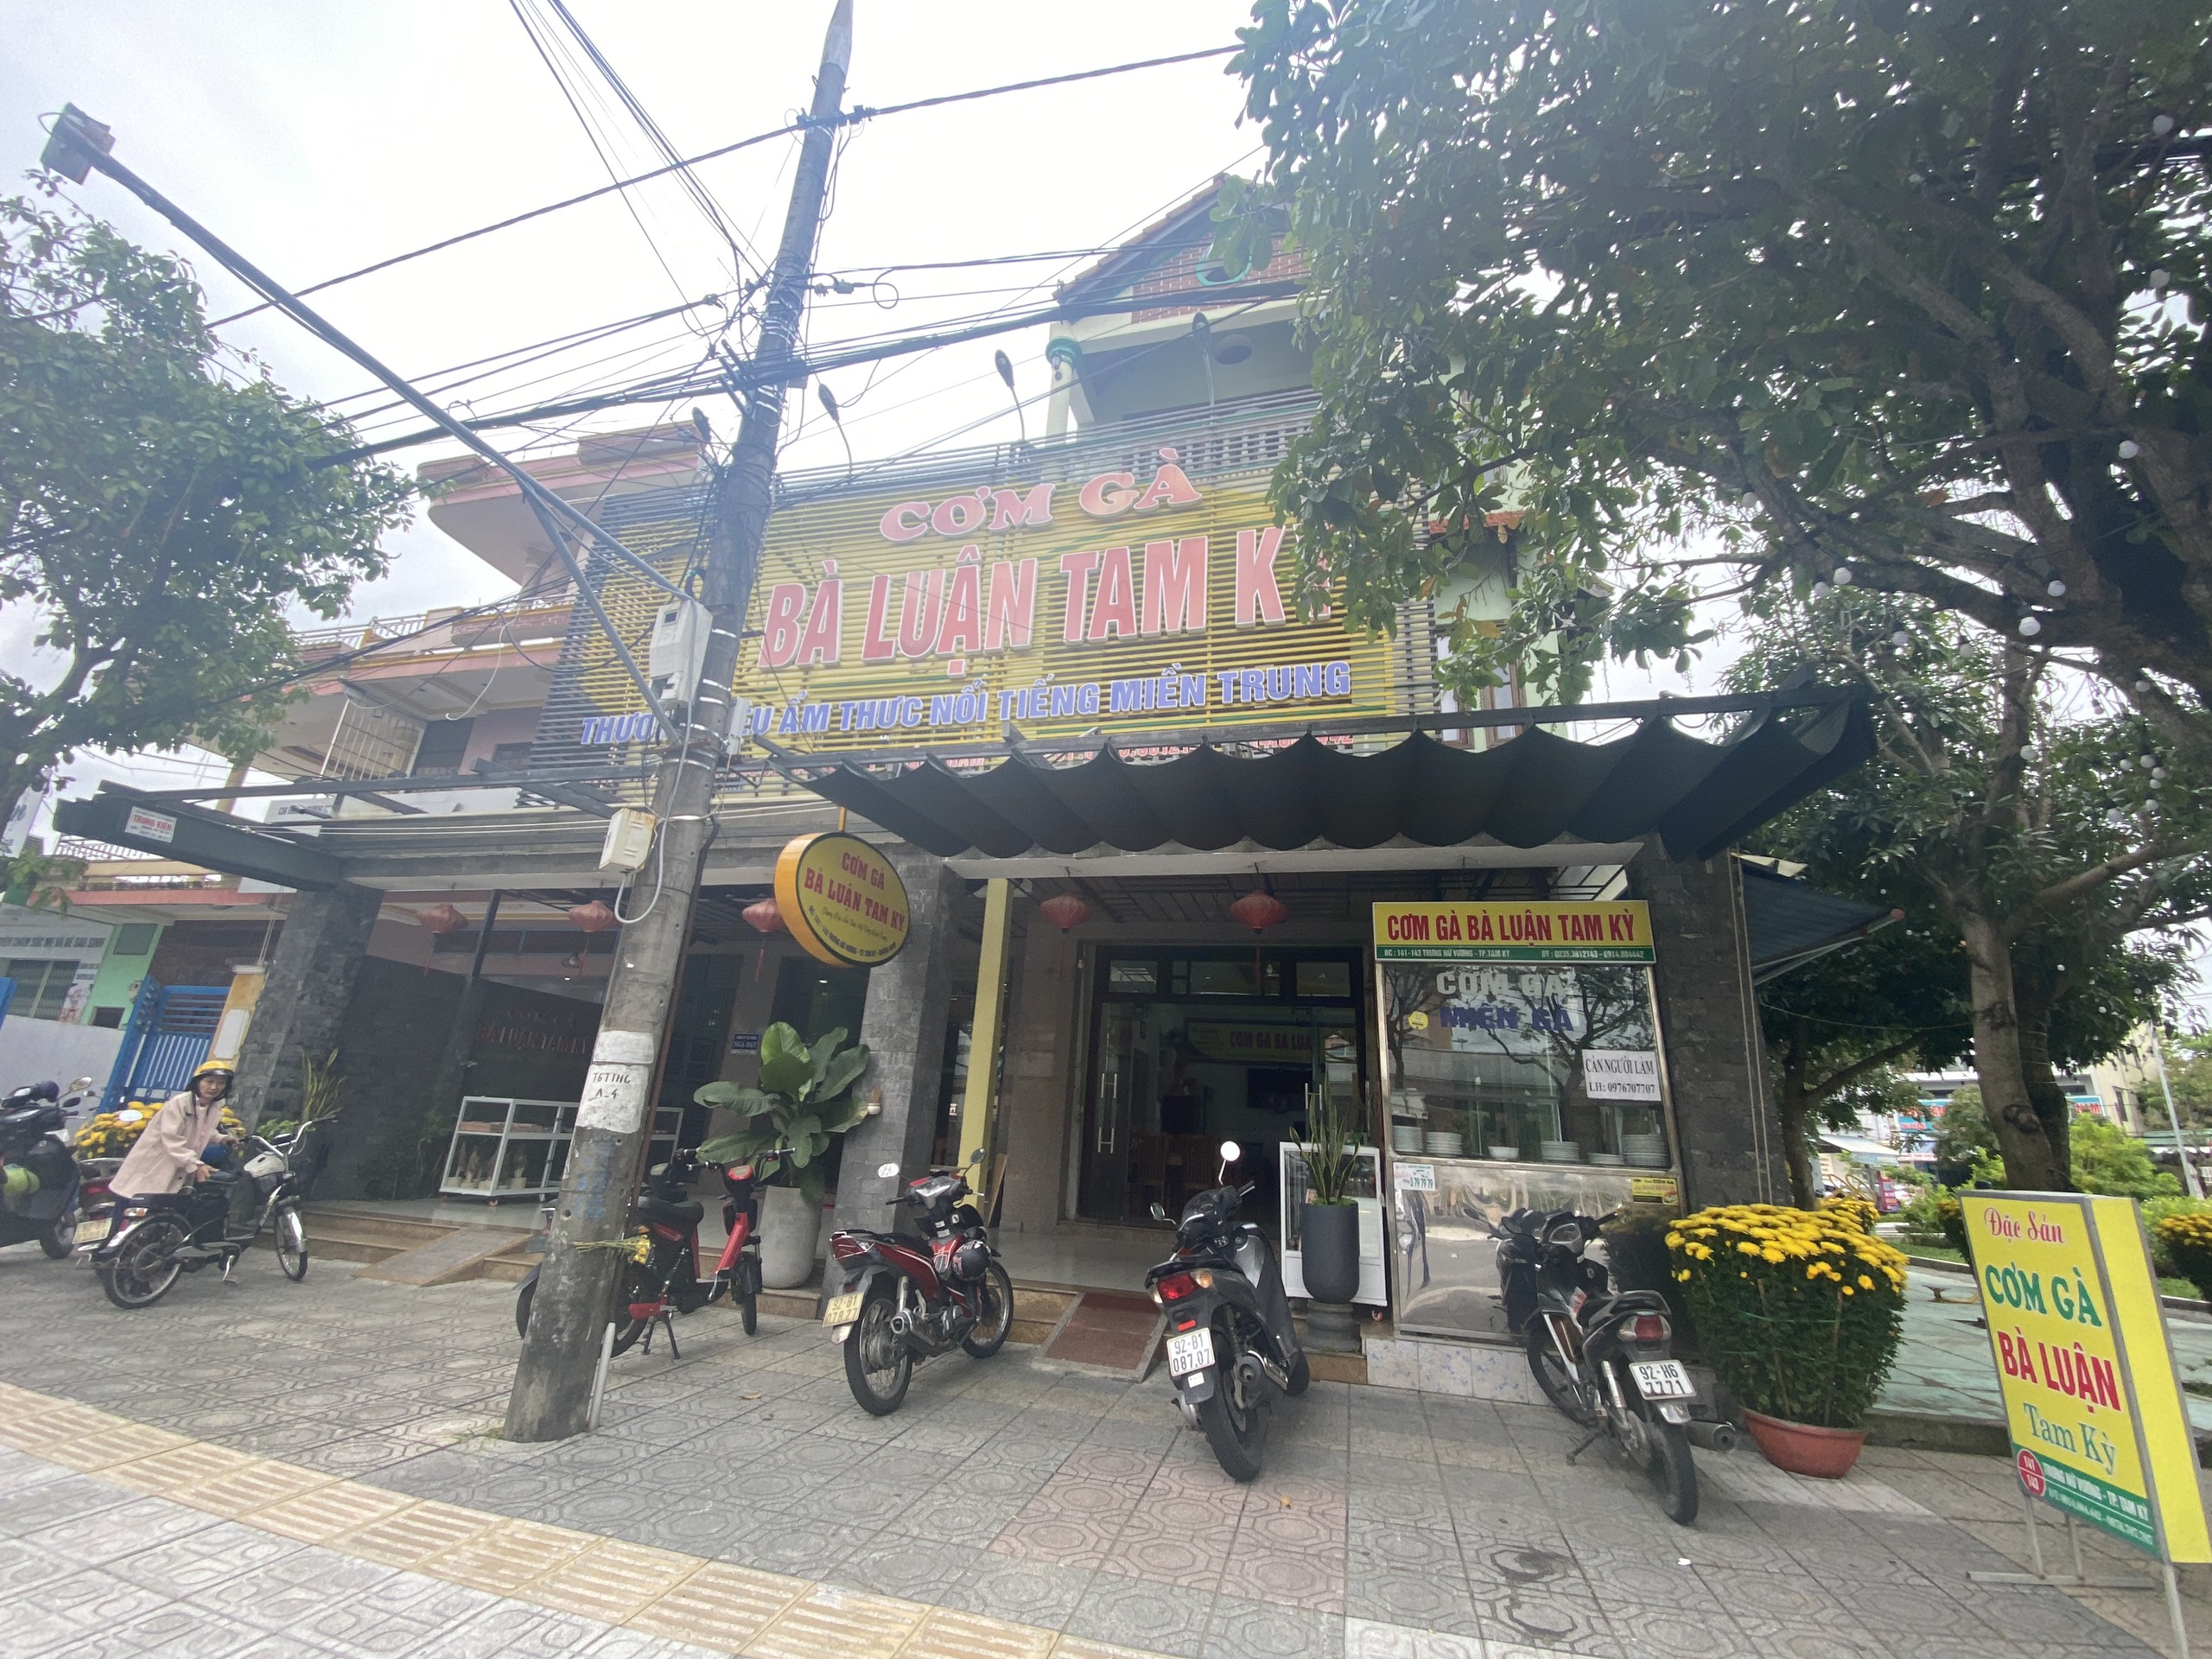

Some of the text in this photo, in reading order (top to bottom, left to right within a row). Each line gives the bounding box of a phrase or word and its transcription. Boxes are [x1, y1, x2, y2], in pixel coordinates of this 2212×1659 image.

[880, 448, 1204, 542] CƠM GÀ
[758, 524, 1332, 677] BÀ LUẬN TAM K
[778, 690, 833, 734] ẨM
[930, 678, 988, 726] NỔI
[997, 674, 1100, 721] TIẾNG
[1109, 664, 1207, 713] MIỀN
[1217, 660, 1352, 705] TRUNG
[804, 866, 823, 895] BÀ
[827, 878, 862, 912] LUẬN
[865, 897, 889, 925] TAM
[842, 851, 886, 891] CƠM GÀ
[1387, 908, 1635, 947] CƠM GÀ BÀ LUẬN TAM KỲ
[1984, 1207, 2065, 1244] Đặc Sản
[1984, 1262, 2103, 1328] CƠM GÀ
[1173, 1348, 1211, 1373] 087.07
[1174, 1332, 1205, 1355] 92-B1
[1639, 1363, 1679, 1380] 92-H6
[1645, 1380, 1686, 1395] 7771
[1997, 1326, 2122, 1414] BÀ LUẬN
[2023, 1402, 2117, 1476] Tam Kỳ
